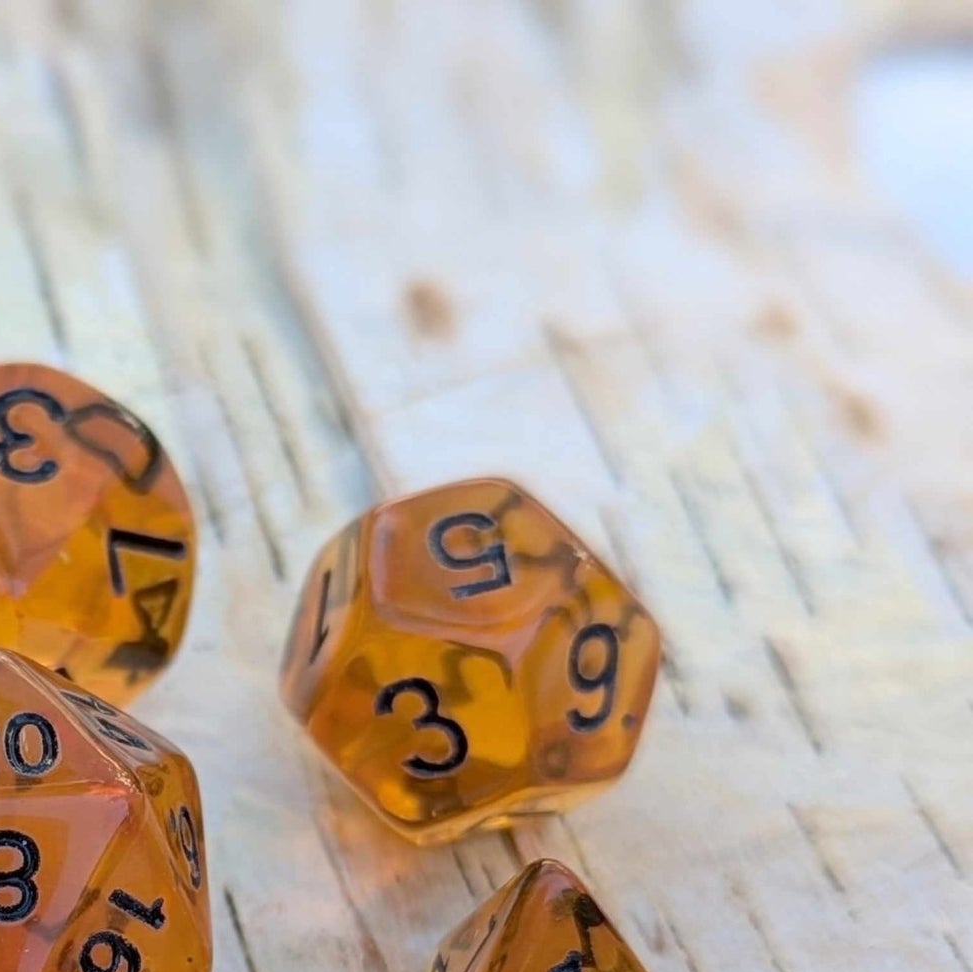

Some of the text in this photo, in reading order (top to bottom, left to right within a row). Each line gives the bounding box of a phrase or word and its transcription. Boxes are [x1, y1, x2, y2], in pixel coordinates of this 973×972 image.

[107, 528, 186, 596] 7
[428, 511, 513, 600] 5
[373, 676, 469, 779] 3
